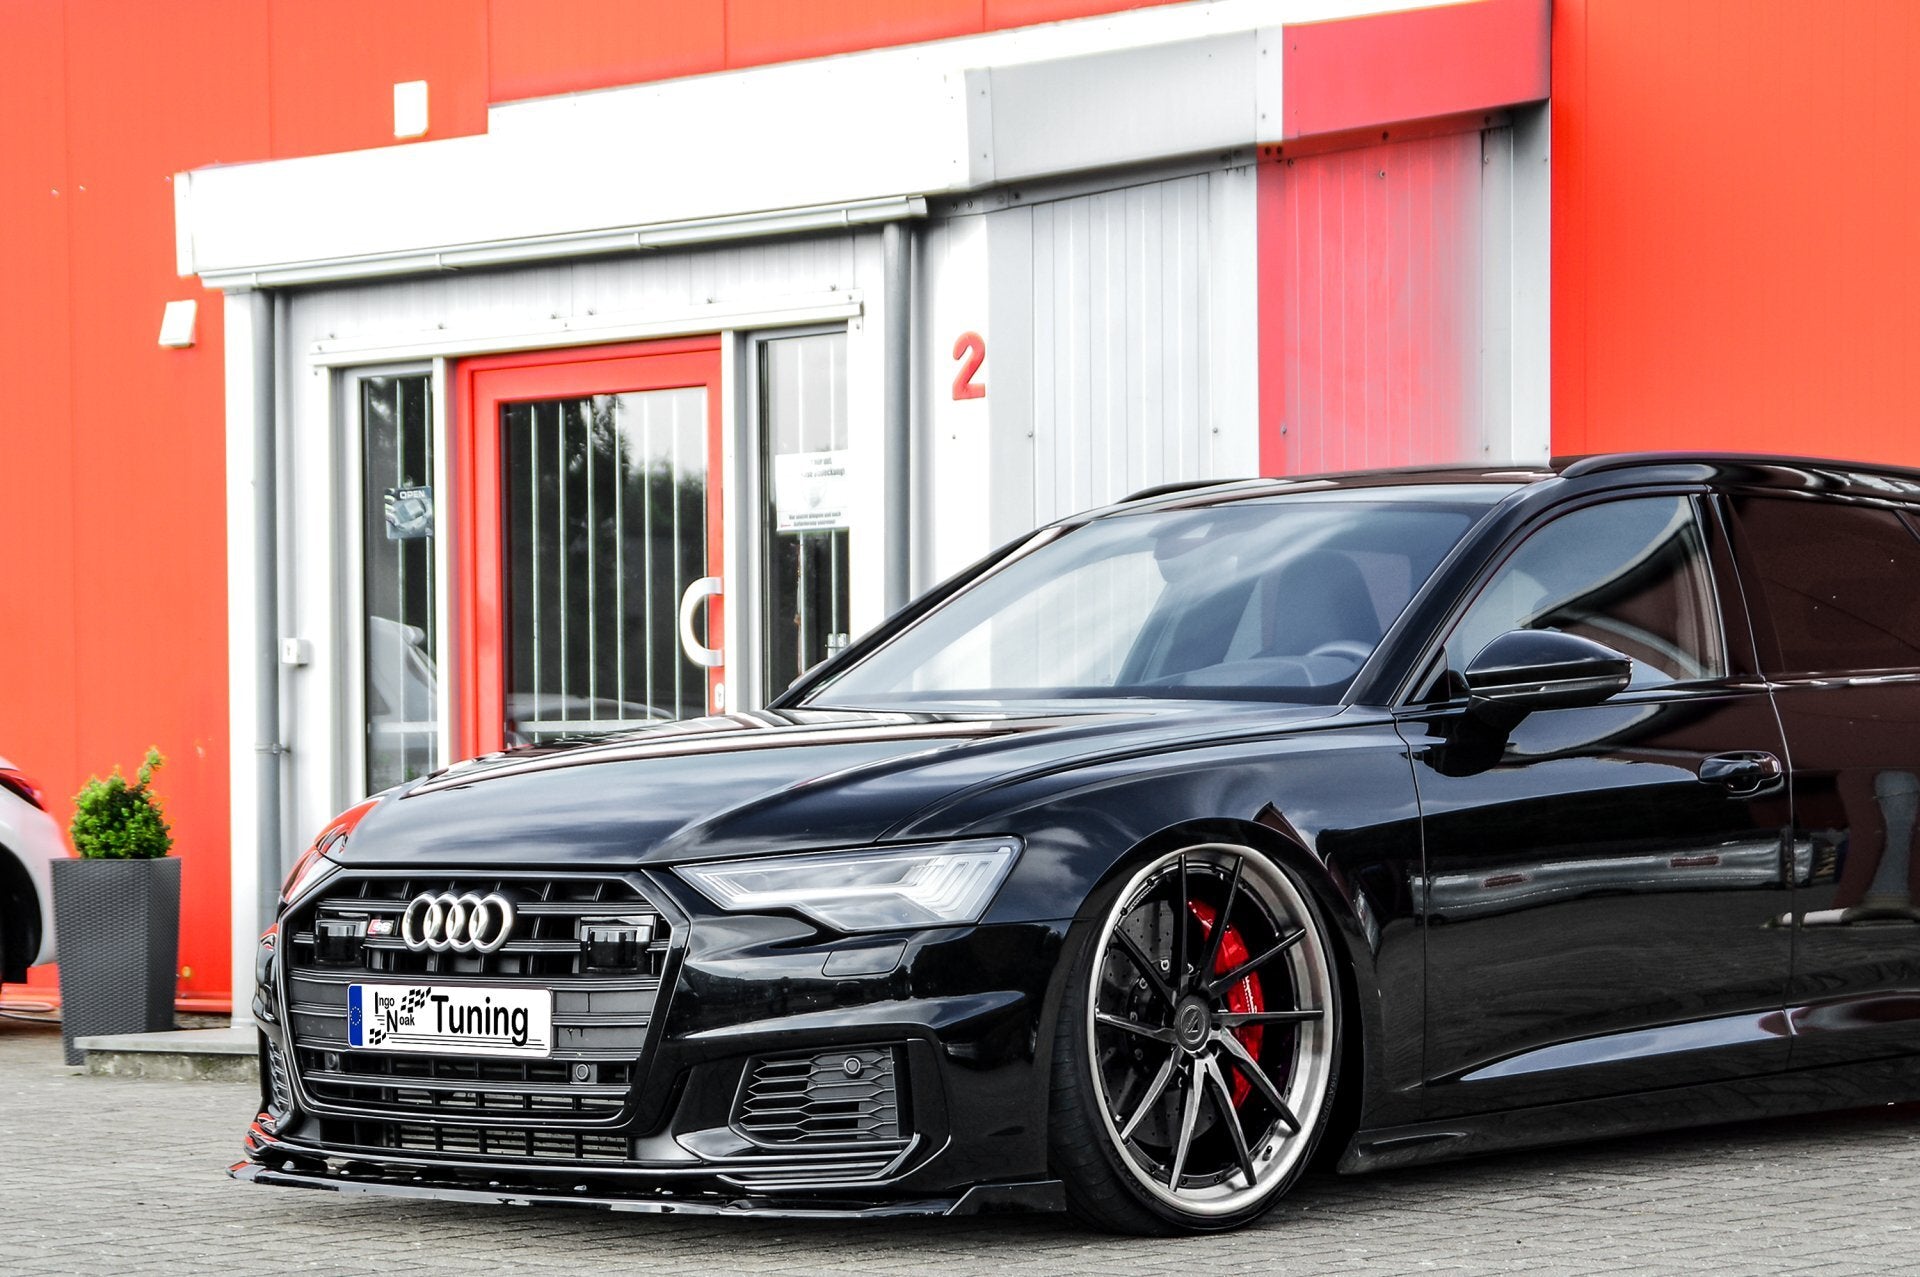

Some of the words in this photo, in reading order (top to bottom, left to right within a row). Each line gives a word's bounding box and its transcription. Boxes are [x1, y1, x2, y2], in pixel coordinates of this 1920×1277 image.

[952, 330, 986, 401] 2
[399, 489, 426, 500] OPEN
[374, 991, 395, 1014] Ingo
[386, 1009, 415, 1033] Noak
[430, 995, 529, 1047] Tuning
